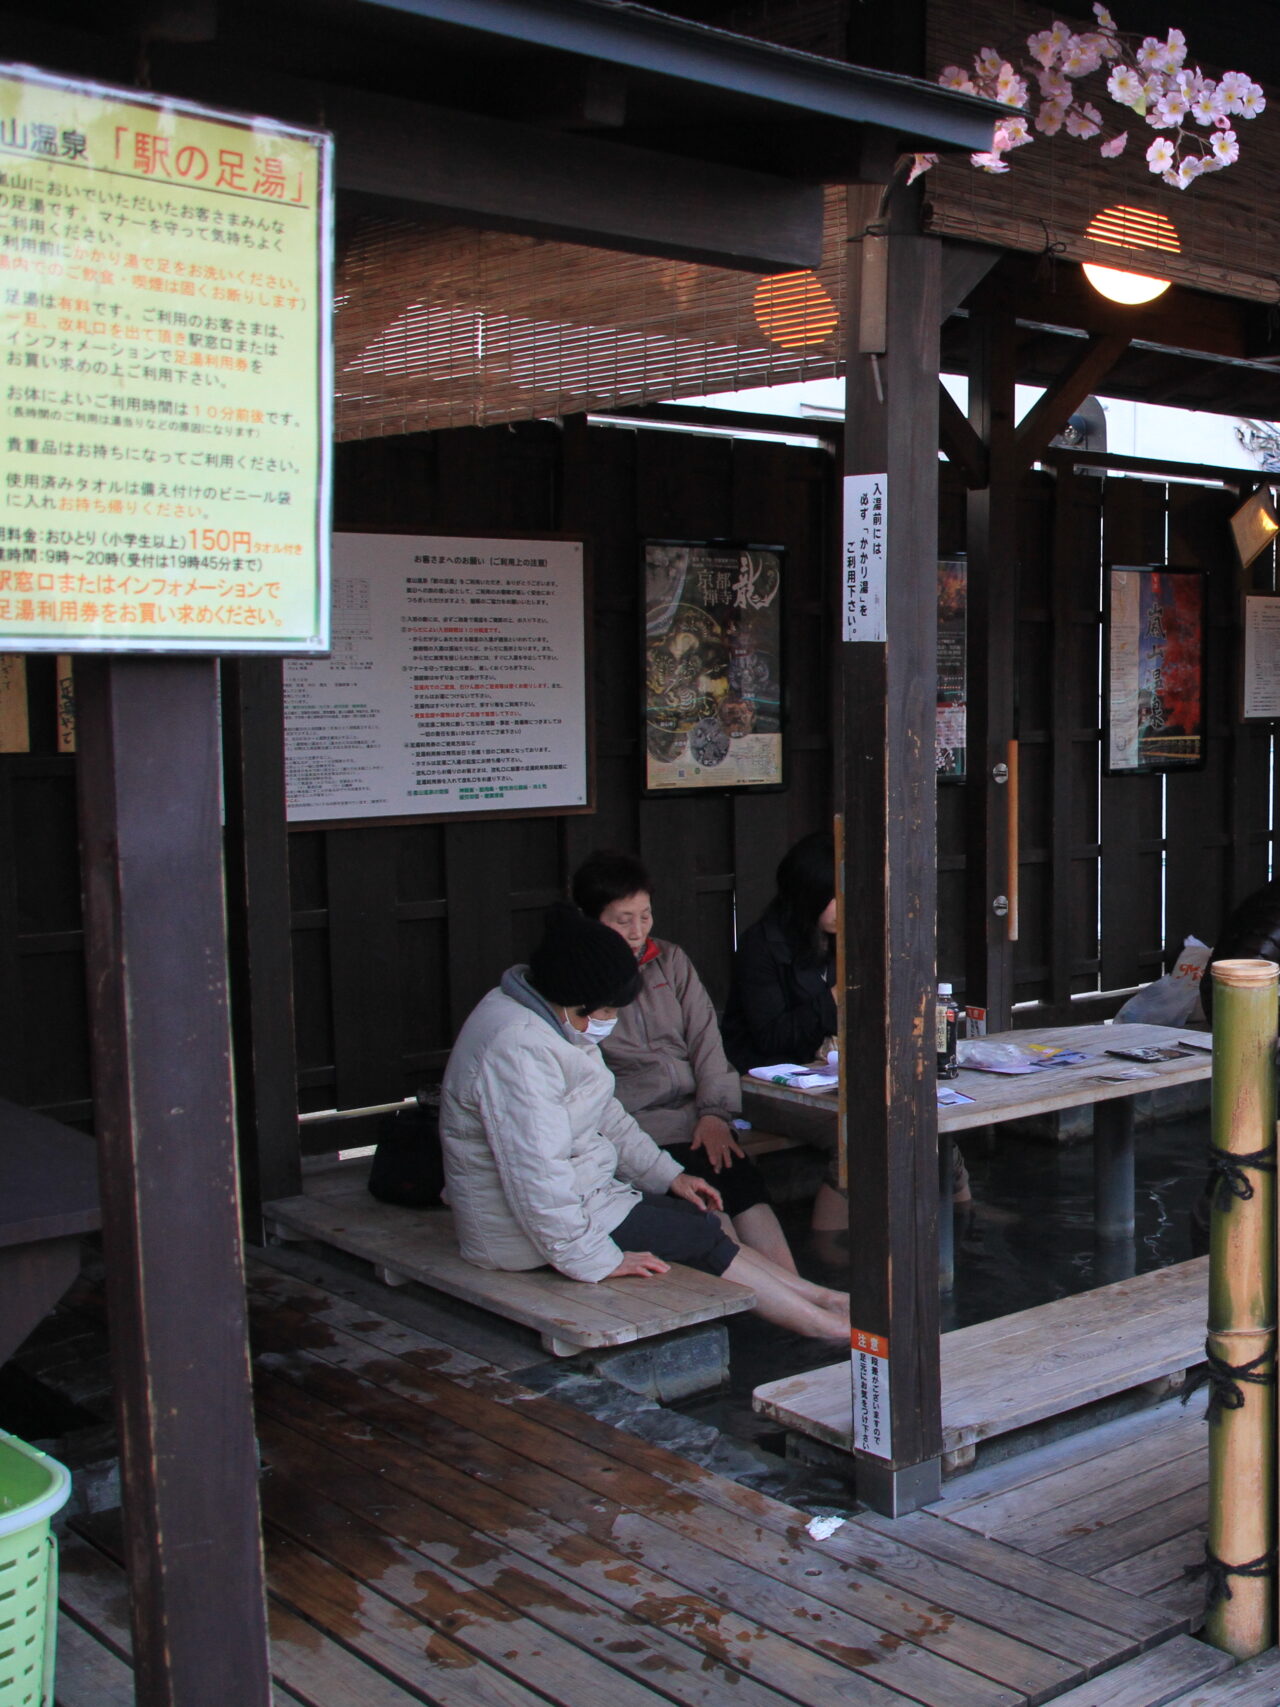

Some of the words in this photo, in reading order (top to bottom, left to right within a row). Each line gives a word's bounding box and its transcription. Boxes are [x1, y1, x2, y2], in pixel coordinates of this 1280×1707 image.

[1, 118, 89, 161] 山温泉
[114, 125, 305, 203] 「駅の足湯」
[6, 350, 228, 389] お買い求めの上ご利用下さい。
[7, 330, 264, 374] インフォメーションで足湯利用券を
[7, 436, 302, 474] 貴重品はお持ちになってご利用ください。
[6, 473, 292, 506] 使用済みタオルは備え付けのビニール袋
[6, 493, 211, 521] に入れお持ち帰りください。
[872, 482, 882, 561] 入湯前には、
[859, 492, 870, 617] 必ず「かかり湯」を
[0, 570, 282, 600] 駅窓口またはインフォメーションで
[846, 540, 857, 635] ご利用下さい。
[0, 600, 284, 628] 足湯利用券をお買い求めください。
[857, 1332, 879, 1353] 注意
